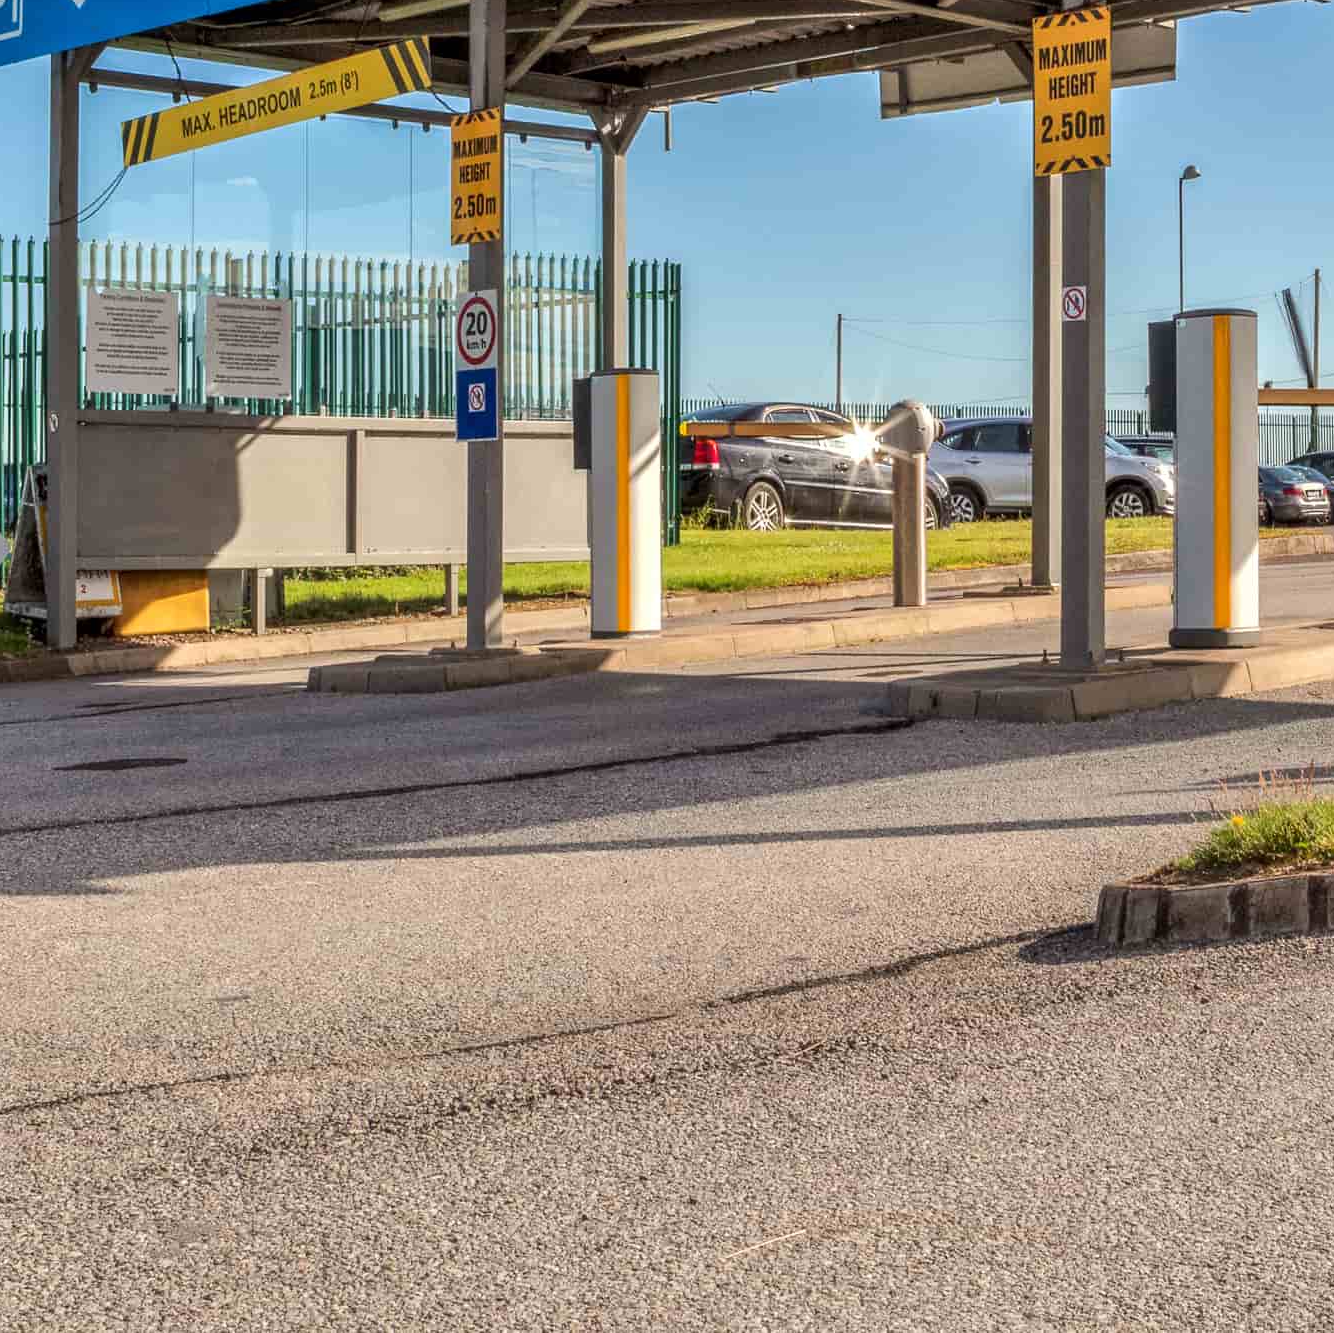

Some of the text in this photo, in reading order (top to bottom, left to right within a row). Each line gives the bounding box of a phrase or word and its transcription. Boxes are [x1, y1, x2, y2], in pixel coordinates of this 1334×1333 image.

[1038, 38, 1107, 71] MAXIMUM
[1048, 72, 1097, 100] HEIGHT
[181, 110, 217, 139] MAX.
[219, 86, 302, 128] HEADROOM
[309, 79, 338, 100] 2.5m
[1040, 109, 1106, 144] 2.50m
[453, 134, 498, 159] MAXIMUM
[459, 161, 491, 184] HEIGHT
[453, 193, 497, 220] 2.50m
[466, 312, 487, 335] 20
